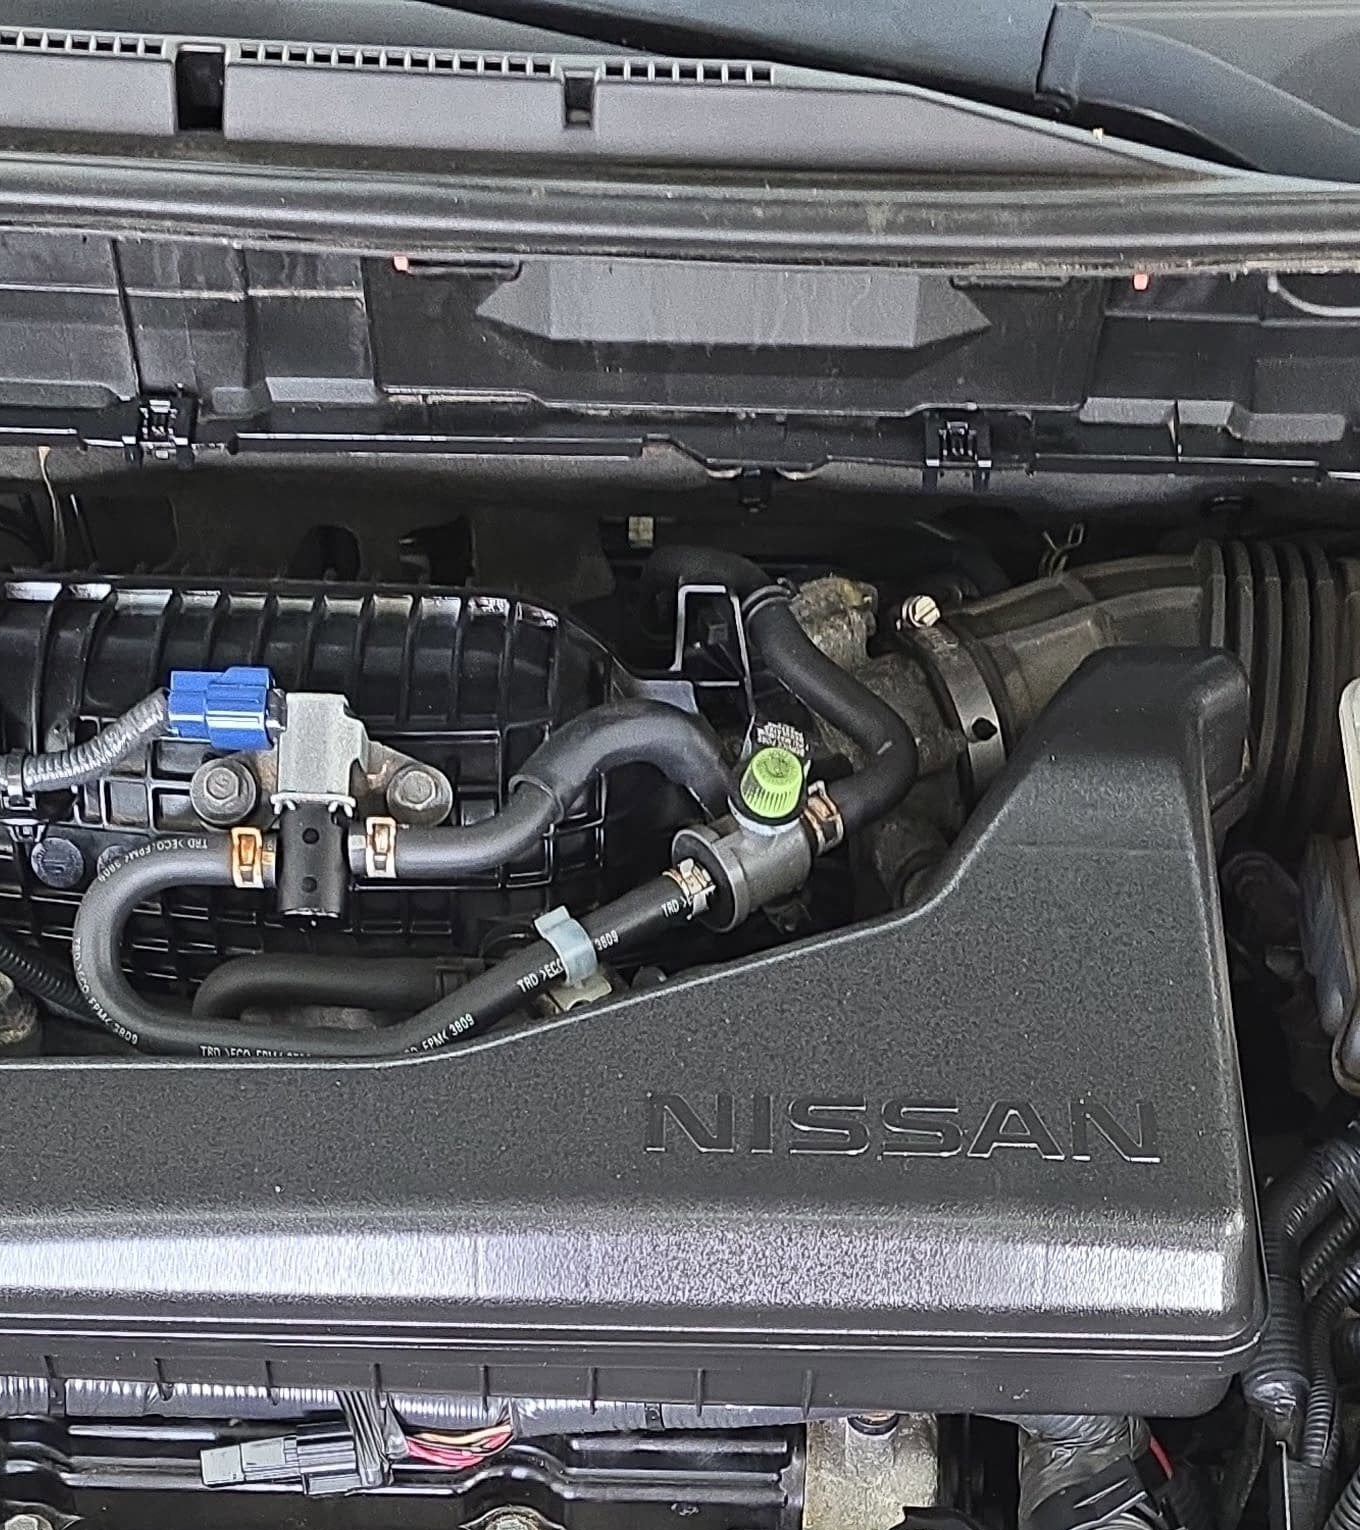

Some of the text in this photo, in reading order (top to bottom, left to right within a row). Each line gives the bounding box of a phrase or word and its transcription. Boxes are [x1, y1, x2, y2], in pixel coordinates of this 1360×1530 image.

[516, 971, 540, 993] TRD
[594, 930, 620, 952] 3809
[111, 1022, 139, 1046] 3809
[448, 1012, 476, 1036] 3809
[643, 1092, 1162, 1164] NISSAN
